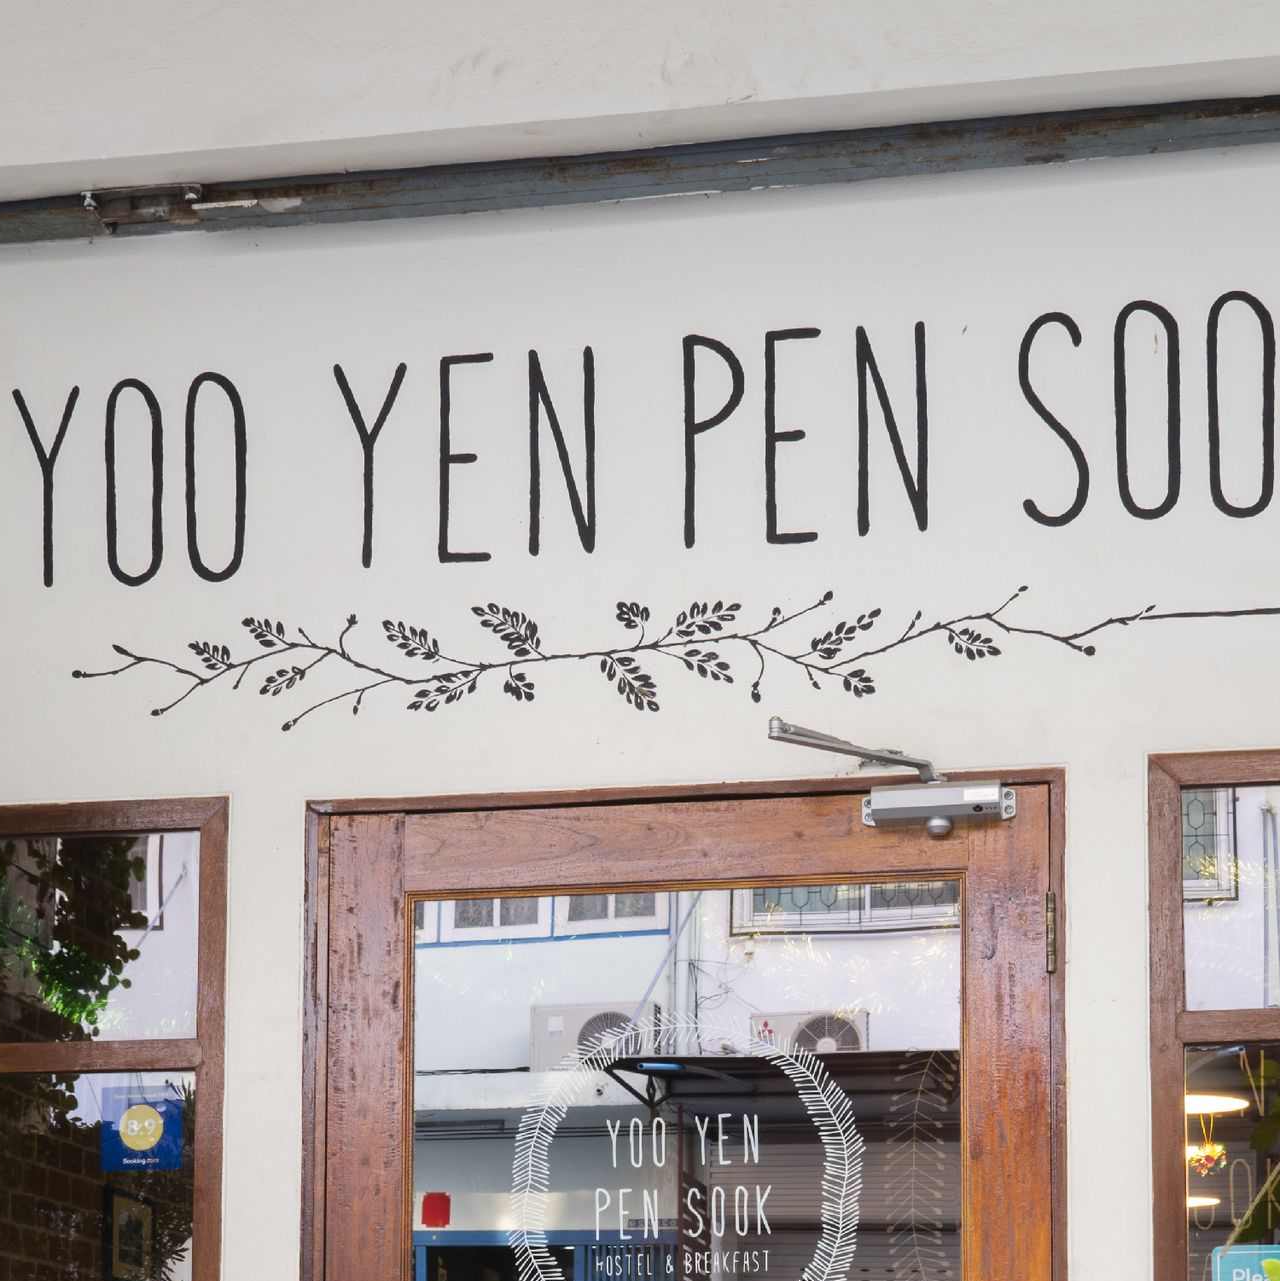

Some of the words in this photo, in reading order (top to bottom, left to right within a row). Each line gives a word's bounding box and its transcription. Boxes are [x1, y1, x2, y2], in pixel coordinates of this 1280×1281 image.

[12, 371, 246, 588] YOO
[333, 346, 596, 569] YEN
[682, 321, 928, 549] PEN
[127, 1118, 156, 1136] 8.9
[606, 1117, 666, 1168] YOO
[695, 1113, 759, 1166] YEN
[595, 1187, 659, 1241] PEN
[686, 1184, 772, 1238] SOOK
[595, 1254, 653, 1276] HOSTEL
[665, 1255, 674, 1274] &
[685, 1250, 769, 1274] BREAKFAST
